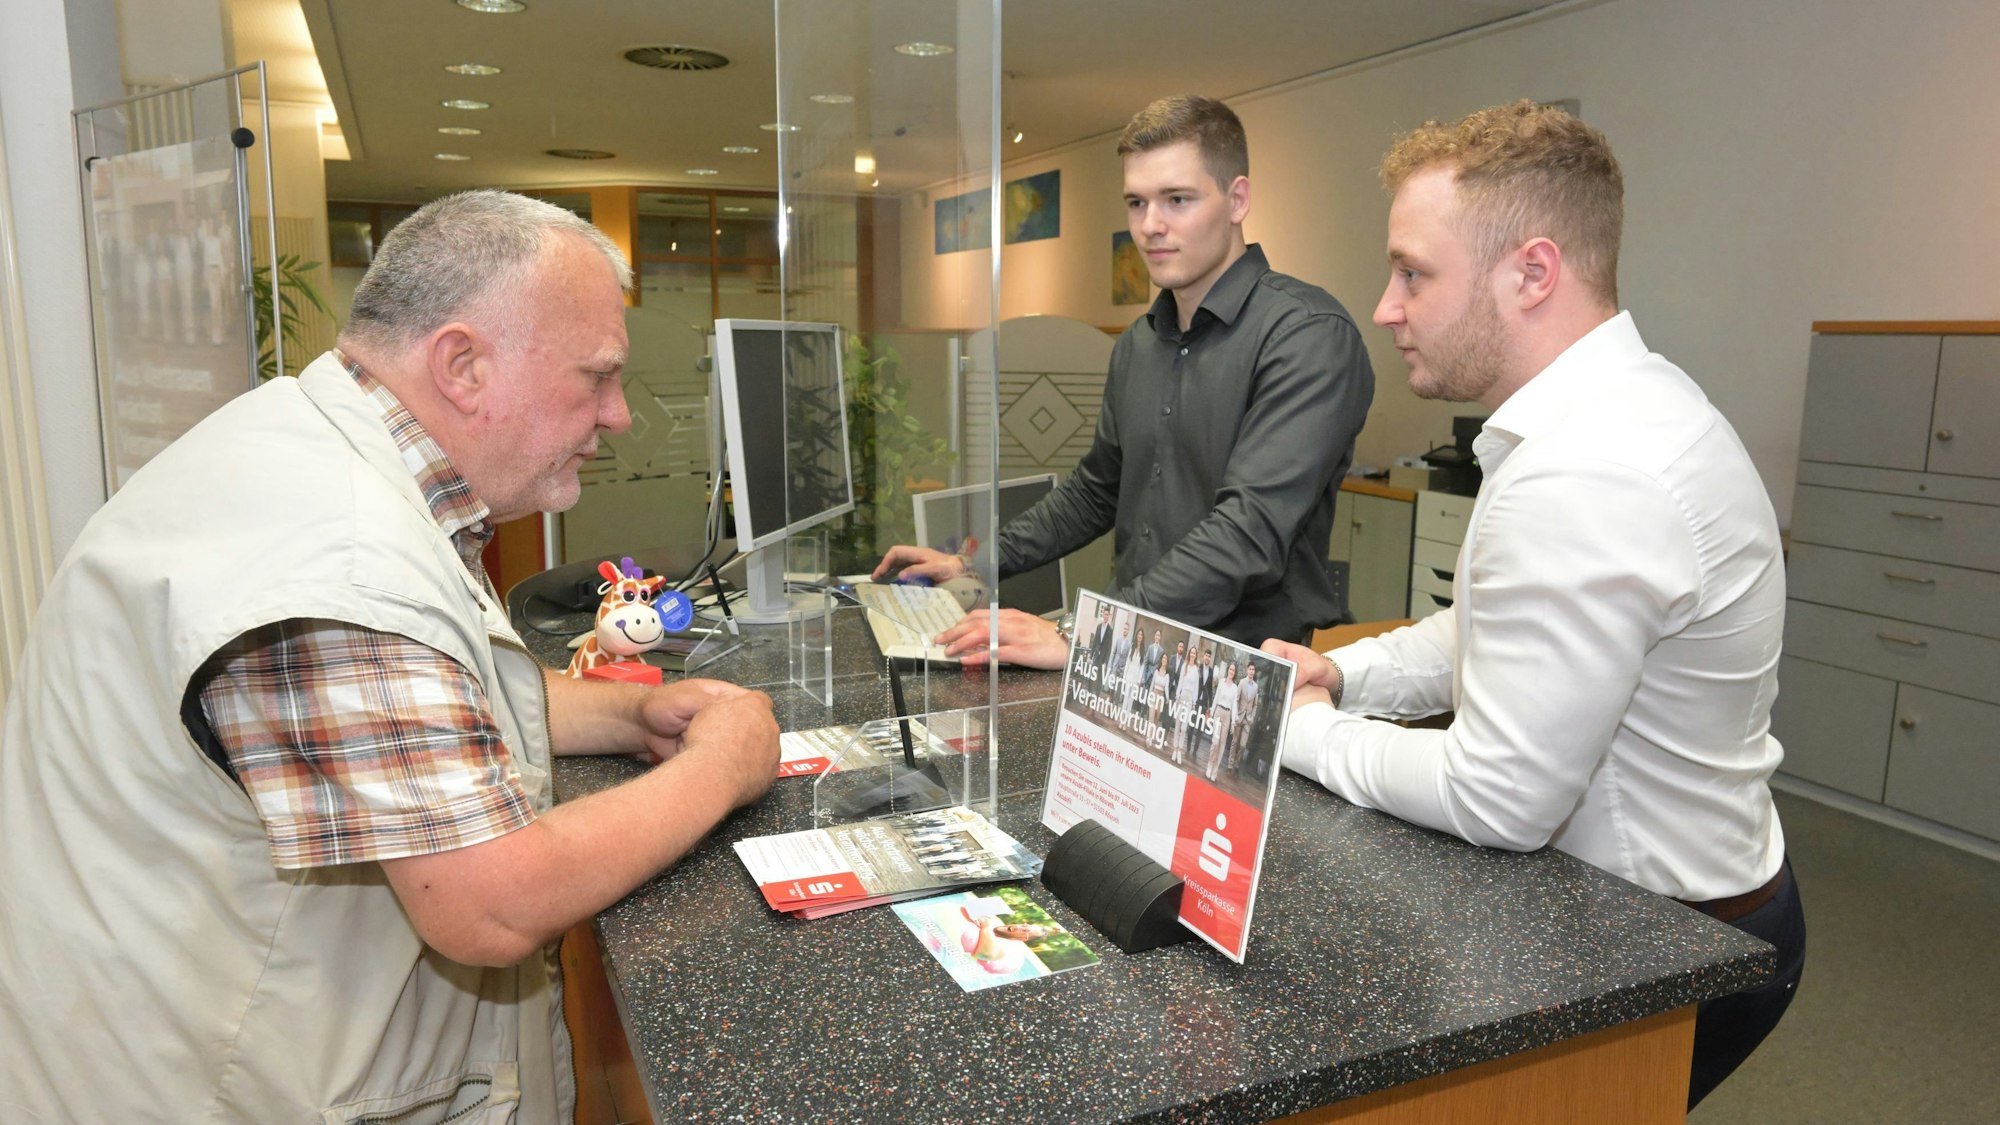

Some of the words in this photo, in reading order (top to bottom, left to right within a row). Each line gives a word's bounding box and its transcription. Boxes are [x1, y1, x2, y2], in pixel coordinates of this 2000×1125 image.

[1072, 679, 1168, 749] Verantwortung.
[1074, 654, 1099, 681] Aus
[1101, 663, 1165, 712] Vertrauen
[1168, 699, 1221, 739] wächst
[1062, 740, 1078, 754] unter
[1078, 747, 1102, 769] Beweis.
[1065, 724, 1072, 735] 10
[1073, 728, 1092, 747] Azubis
[1093, 741, 1115, 758] stellen
[1115, 751, 1125, 764] ihr
[1125, 757, 1152, 780] Können
[852, 827, 878, 852] wächst
[870, 826, 888, 839] Aus
[880, 838, 913, 873] Vertrauen
[1183, 873, 1235, 916] Kreissparkasse
[1197, 899, 1214, 918] Köln
